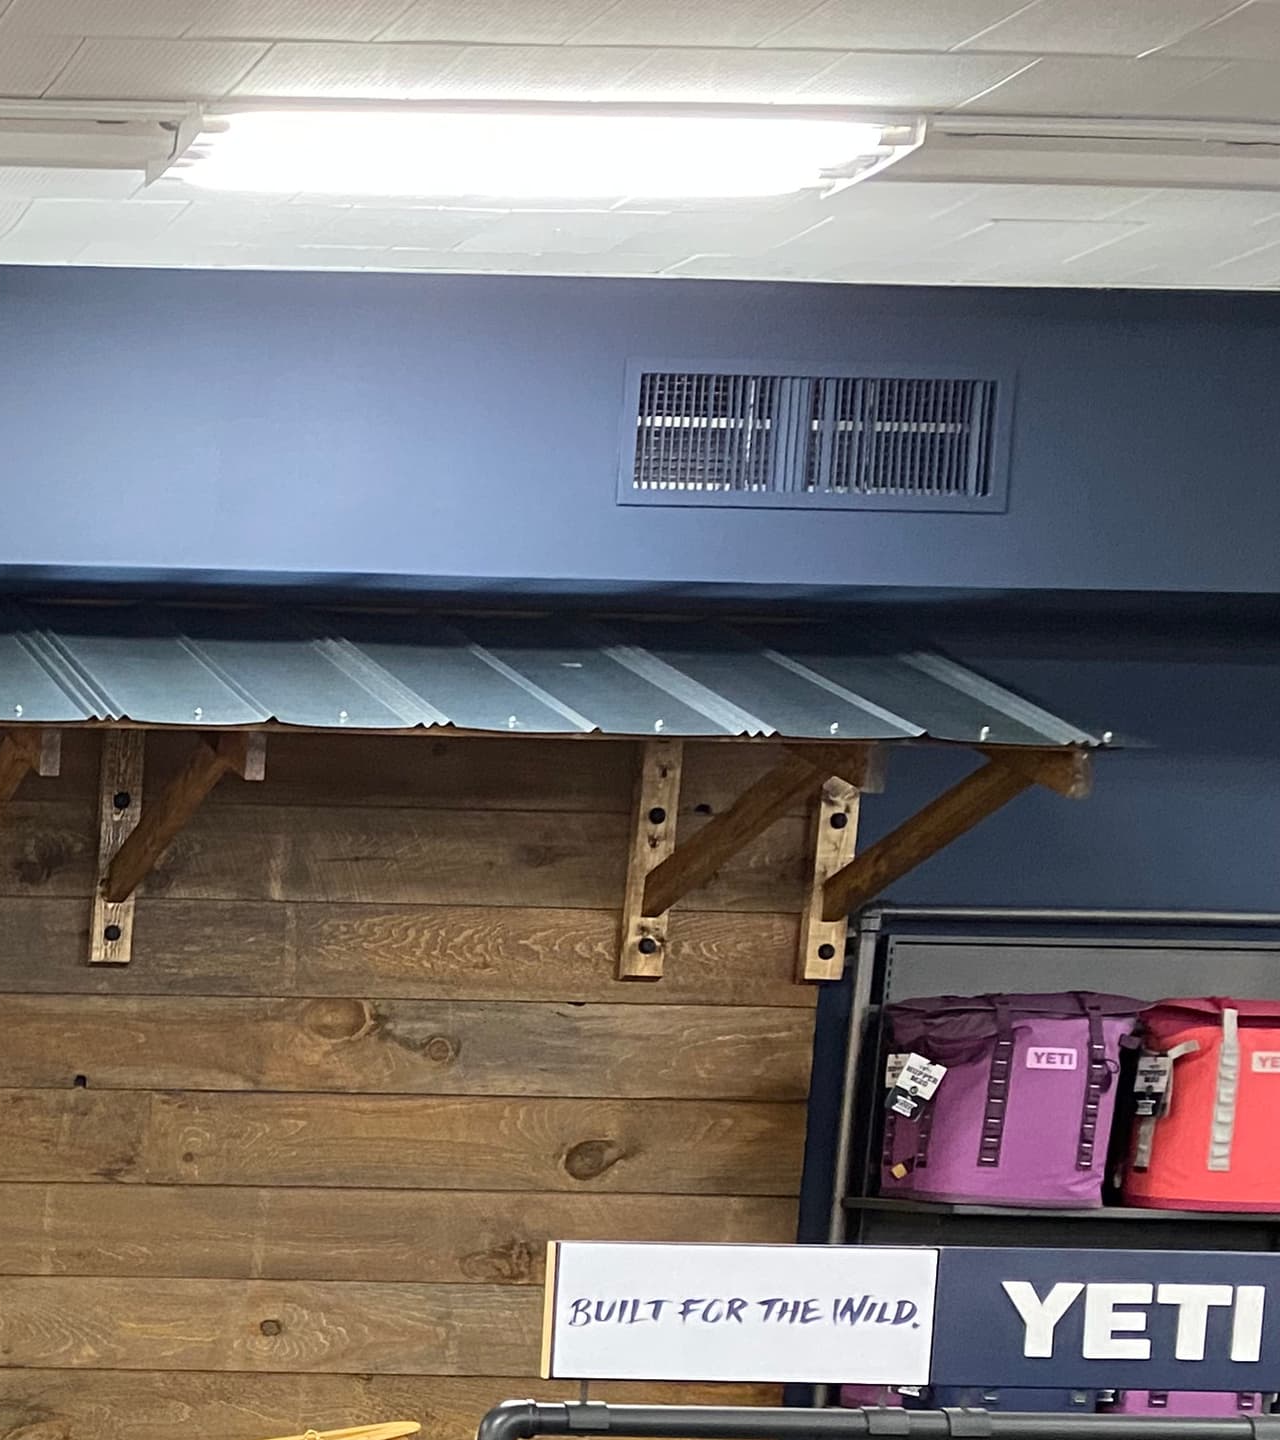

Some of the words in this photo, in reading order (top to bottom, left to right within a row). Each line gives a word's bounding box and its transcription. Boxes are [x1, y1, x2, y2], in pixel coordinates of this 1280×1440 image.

[1033, 1052, 1073, 1066] YETI
[1258, 1056, 1280, 1069] YE
[568, 1297, 672, 1328] BUILT
[677, 1297, 749, 1327] FOR
[757, 1297, 824, 1327] THE
[832, 1293, 921, 1329] WILD.
[1000, 1280, 1266, 1363] YETI
